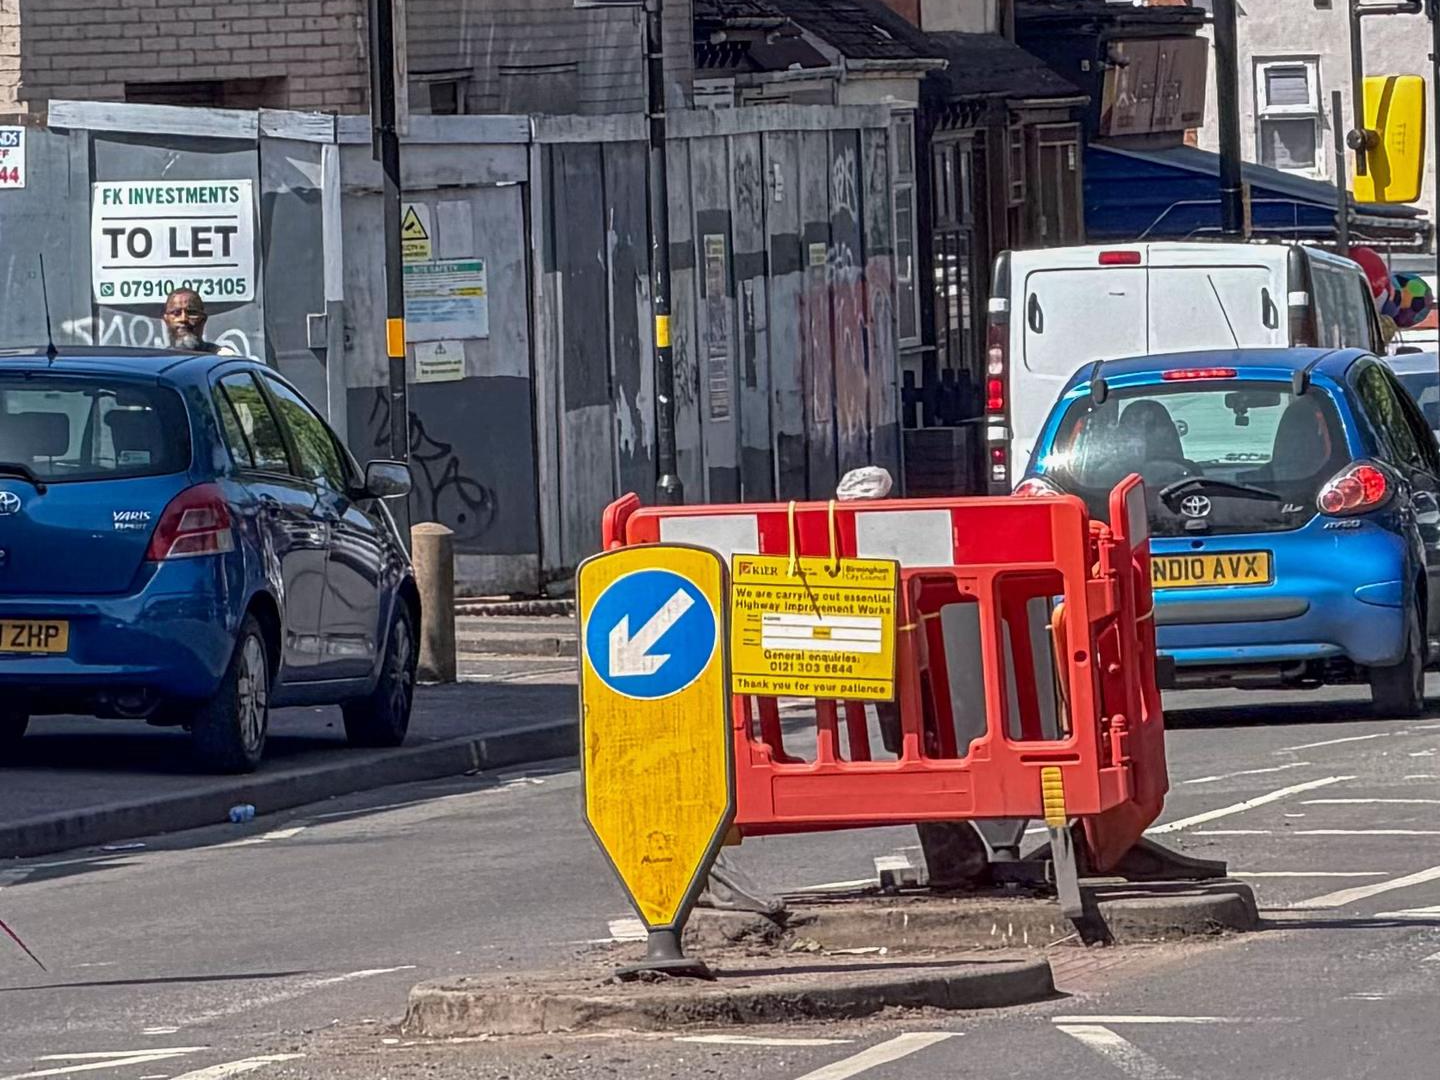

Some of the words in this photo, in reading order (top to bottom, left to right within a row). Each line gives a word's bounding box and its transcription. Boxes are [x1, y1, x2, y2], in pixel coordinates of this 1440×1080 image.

[102, 187, 123, 206] FK
[128, 185, 240, 205] INVESTMENTS
[102, 226, 153, 259] TO
[168, 225, 239, 258] LET
[120, 279, 175, 298] 07910
[1153, 558, 1204, 583] ND10
[1212, 555, 1259, 580] AVX
[736, 587, 753, 598] We
[755, 590, 773, 599] are
[822, 592, 841, 601] out
[843, 593, 891, 603] essential
[735, 598, 780, 612] Highway
[857, 603, 891, 615] Works
[10, 623, 60, 648] ZHP
[763, 649, 805, 661] General
[770, 661, 794, 672] 0121
[797, 662, 821, 673] 303
[737, 678, 769, 689] Thank
[772, 681, 791, 691] you
[794, 681, 810, 690] for
[813, 683, 836, 693] your
[840, 683, 886, 694] patience
